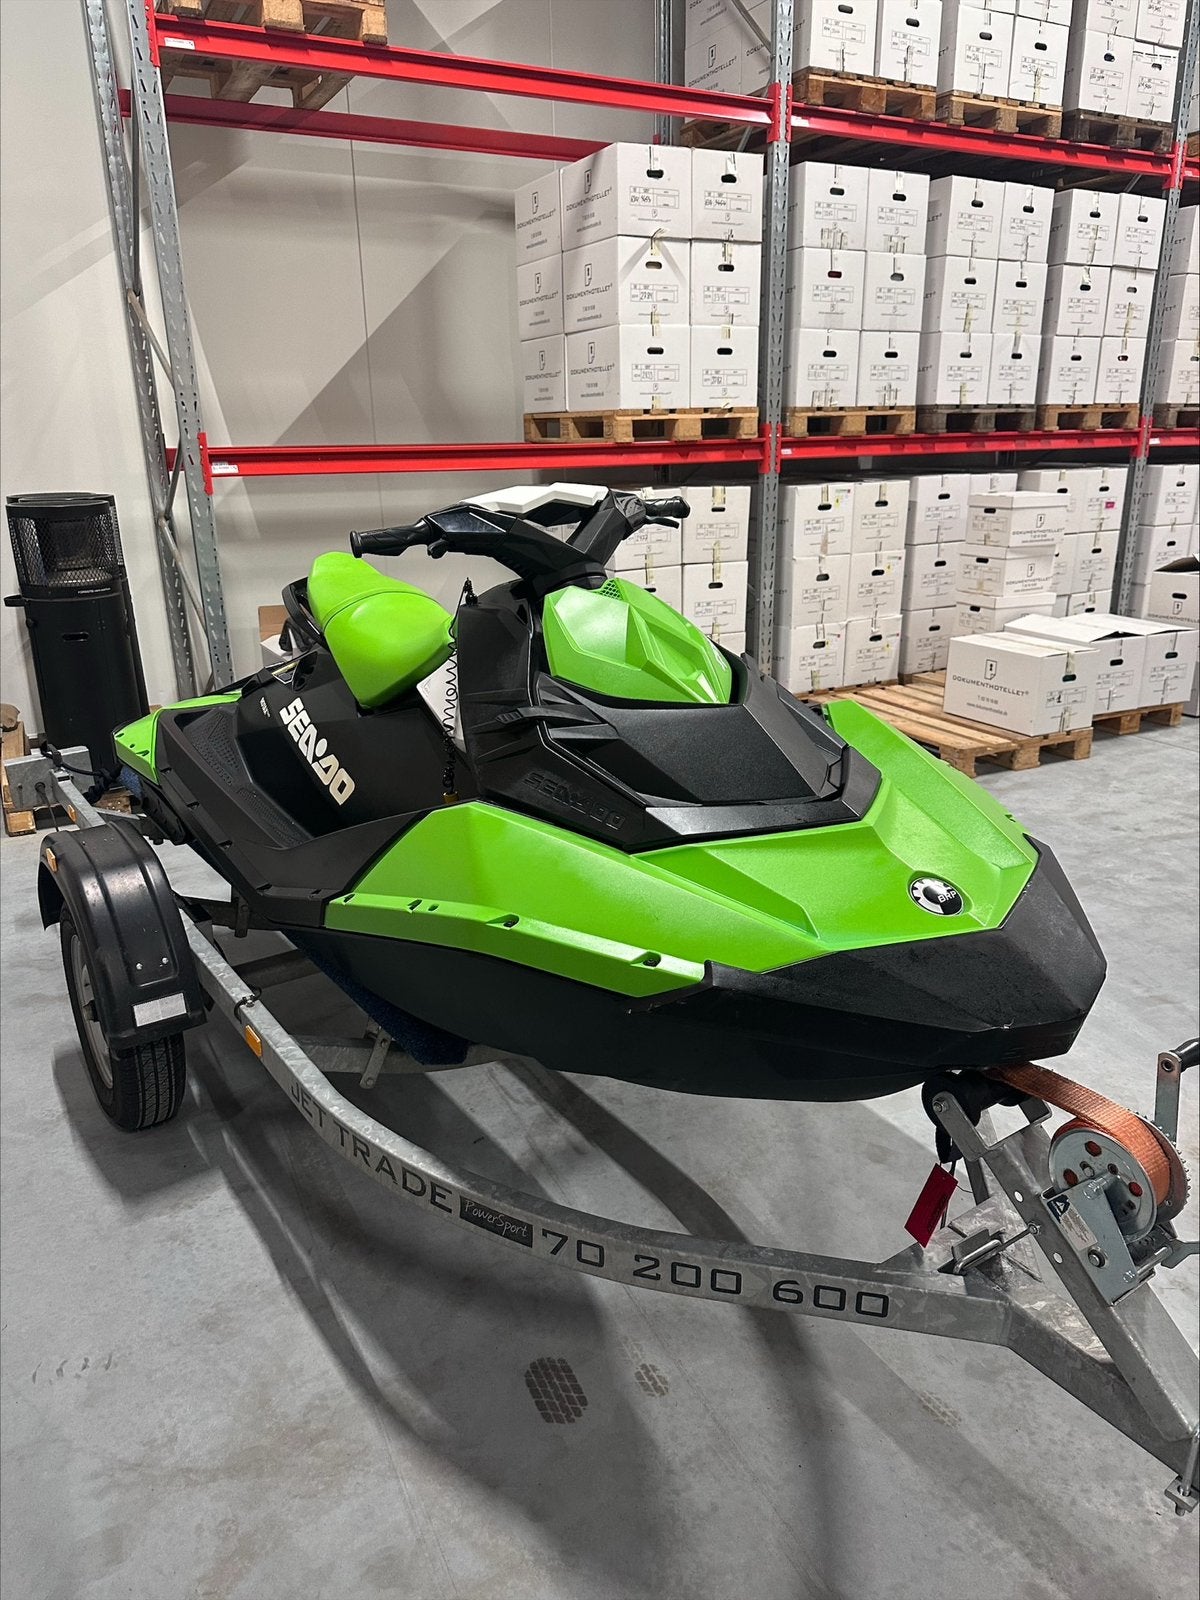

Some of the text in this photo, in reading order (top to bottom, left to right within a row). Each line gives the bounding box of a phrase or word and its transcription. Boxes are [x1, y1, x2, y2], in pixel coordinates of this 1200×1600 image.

[937, 890, 957, 903] BRP
[290, 1082, 890, 1318] JET TRADE PowerSport 70 200 600
